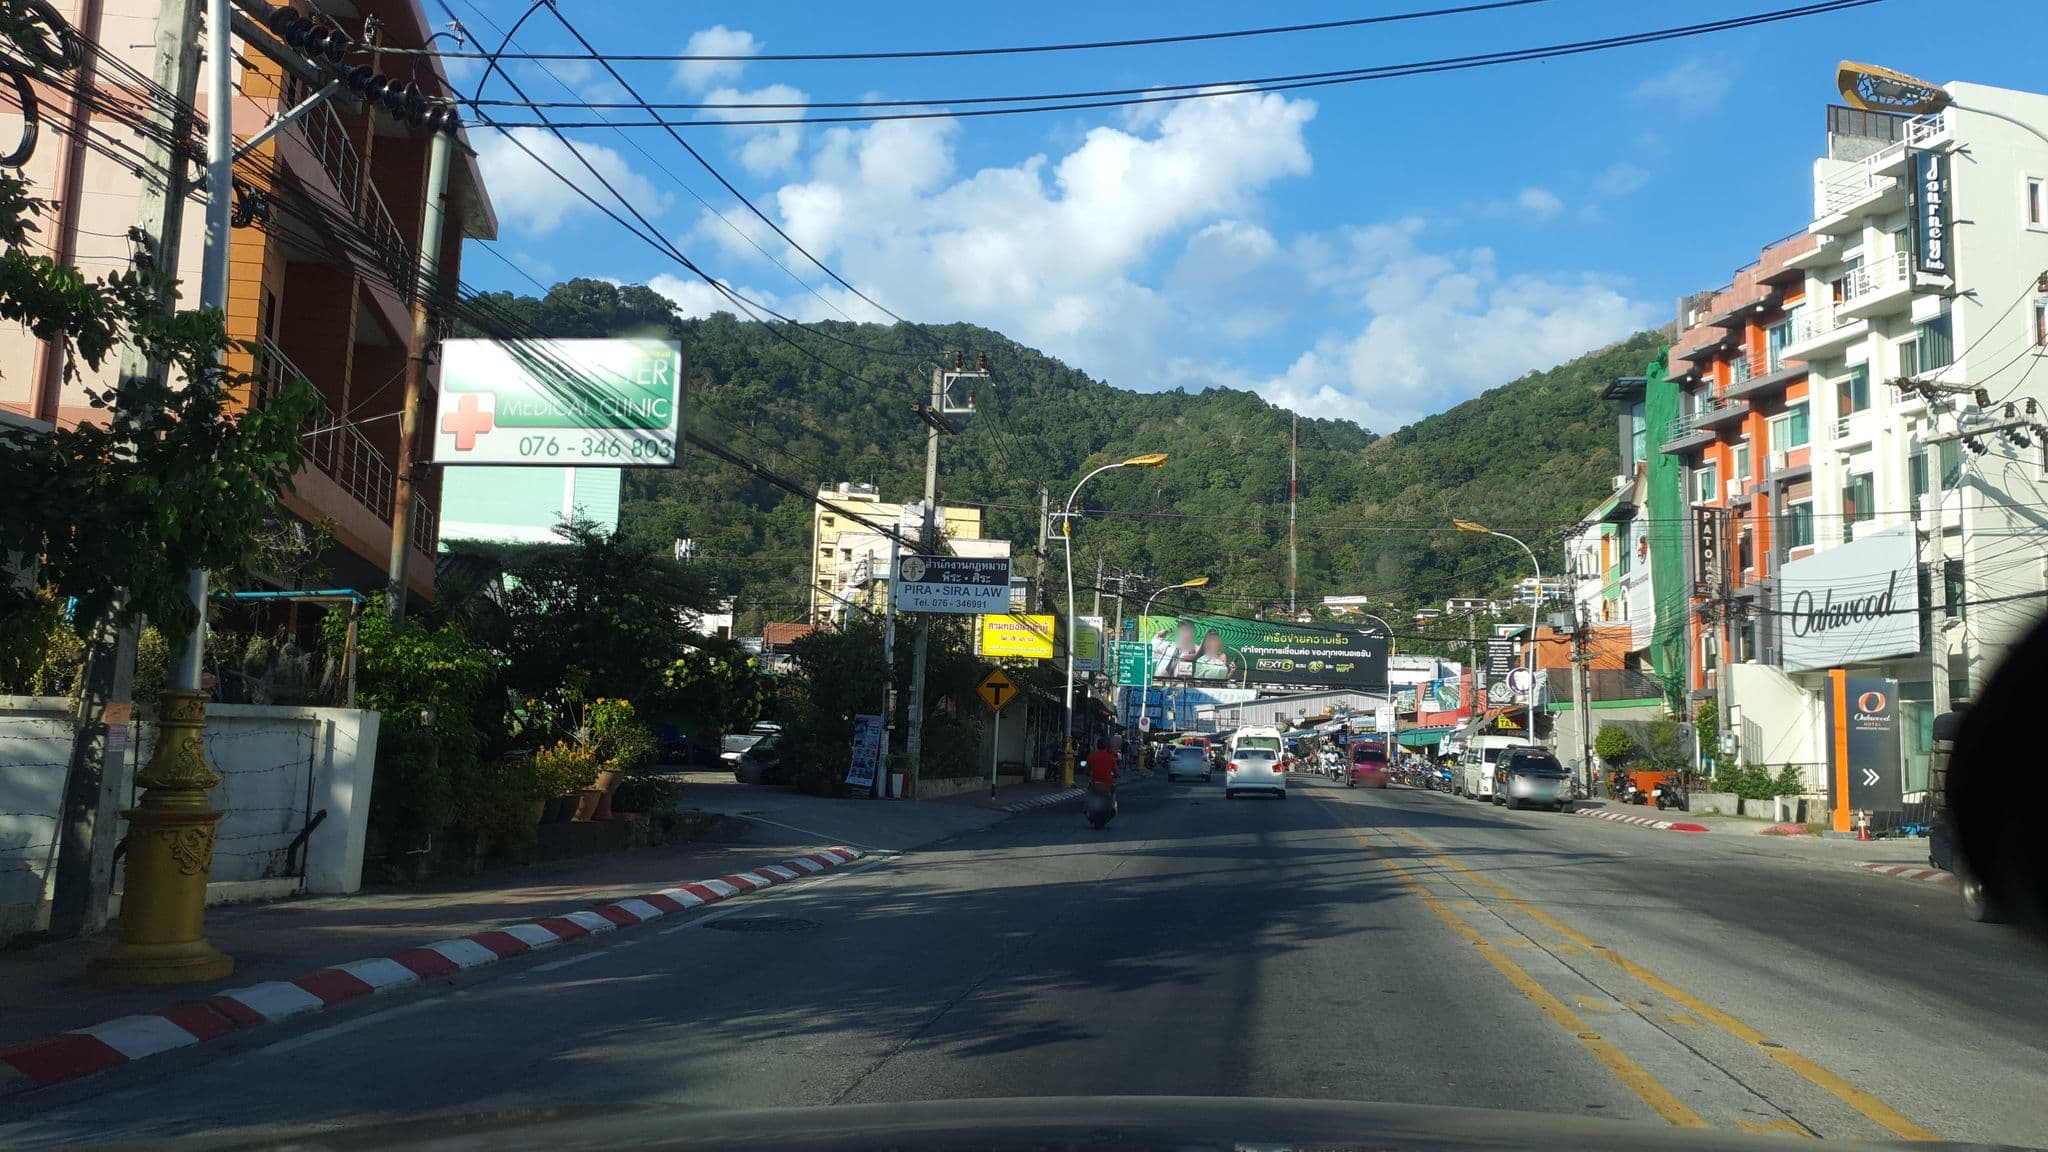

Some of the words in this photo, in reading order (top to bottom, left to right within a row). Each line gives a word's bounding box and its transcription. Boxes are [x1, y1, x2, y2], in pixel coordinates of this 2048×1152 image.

[502, 398, 590, 418] MEDICAL
[601, 398, 668, 418] CLINIC
[519, 436, 560, 456] 076
[581, 437, 621, 457] 346
[631, 438, 673, 459] 803
[904, 584, 932, 594] PIRA
[942, 586, 970, 596] SIRA
[975, 587, 1002, 597] LAW
[914, 598, 930, 607] Tel.
[932, 599, 948, 607] 076
[956, 600, 986, 608] 346991
[1791, 569, 1897, 638] Oakwood
